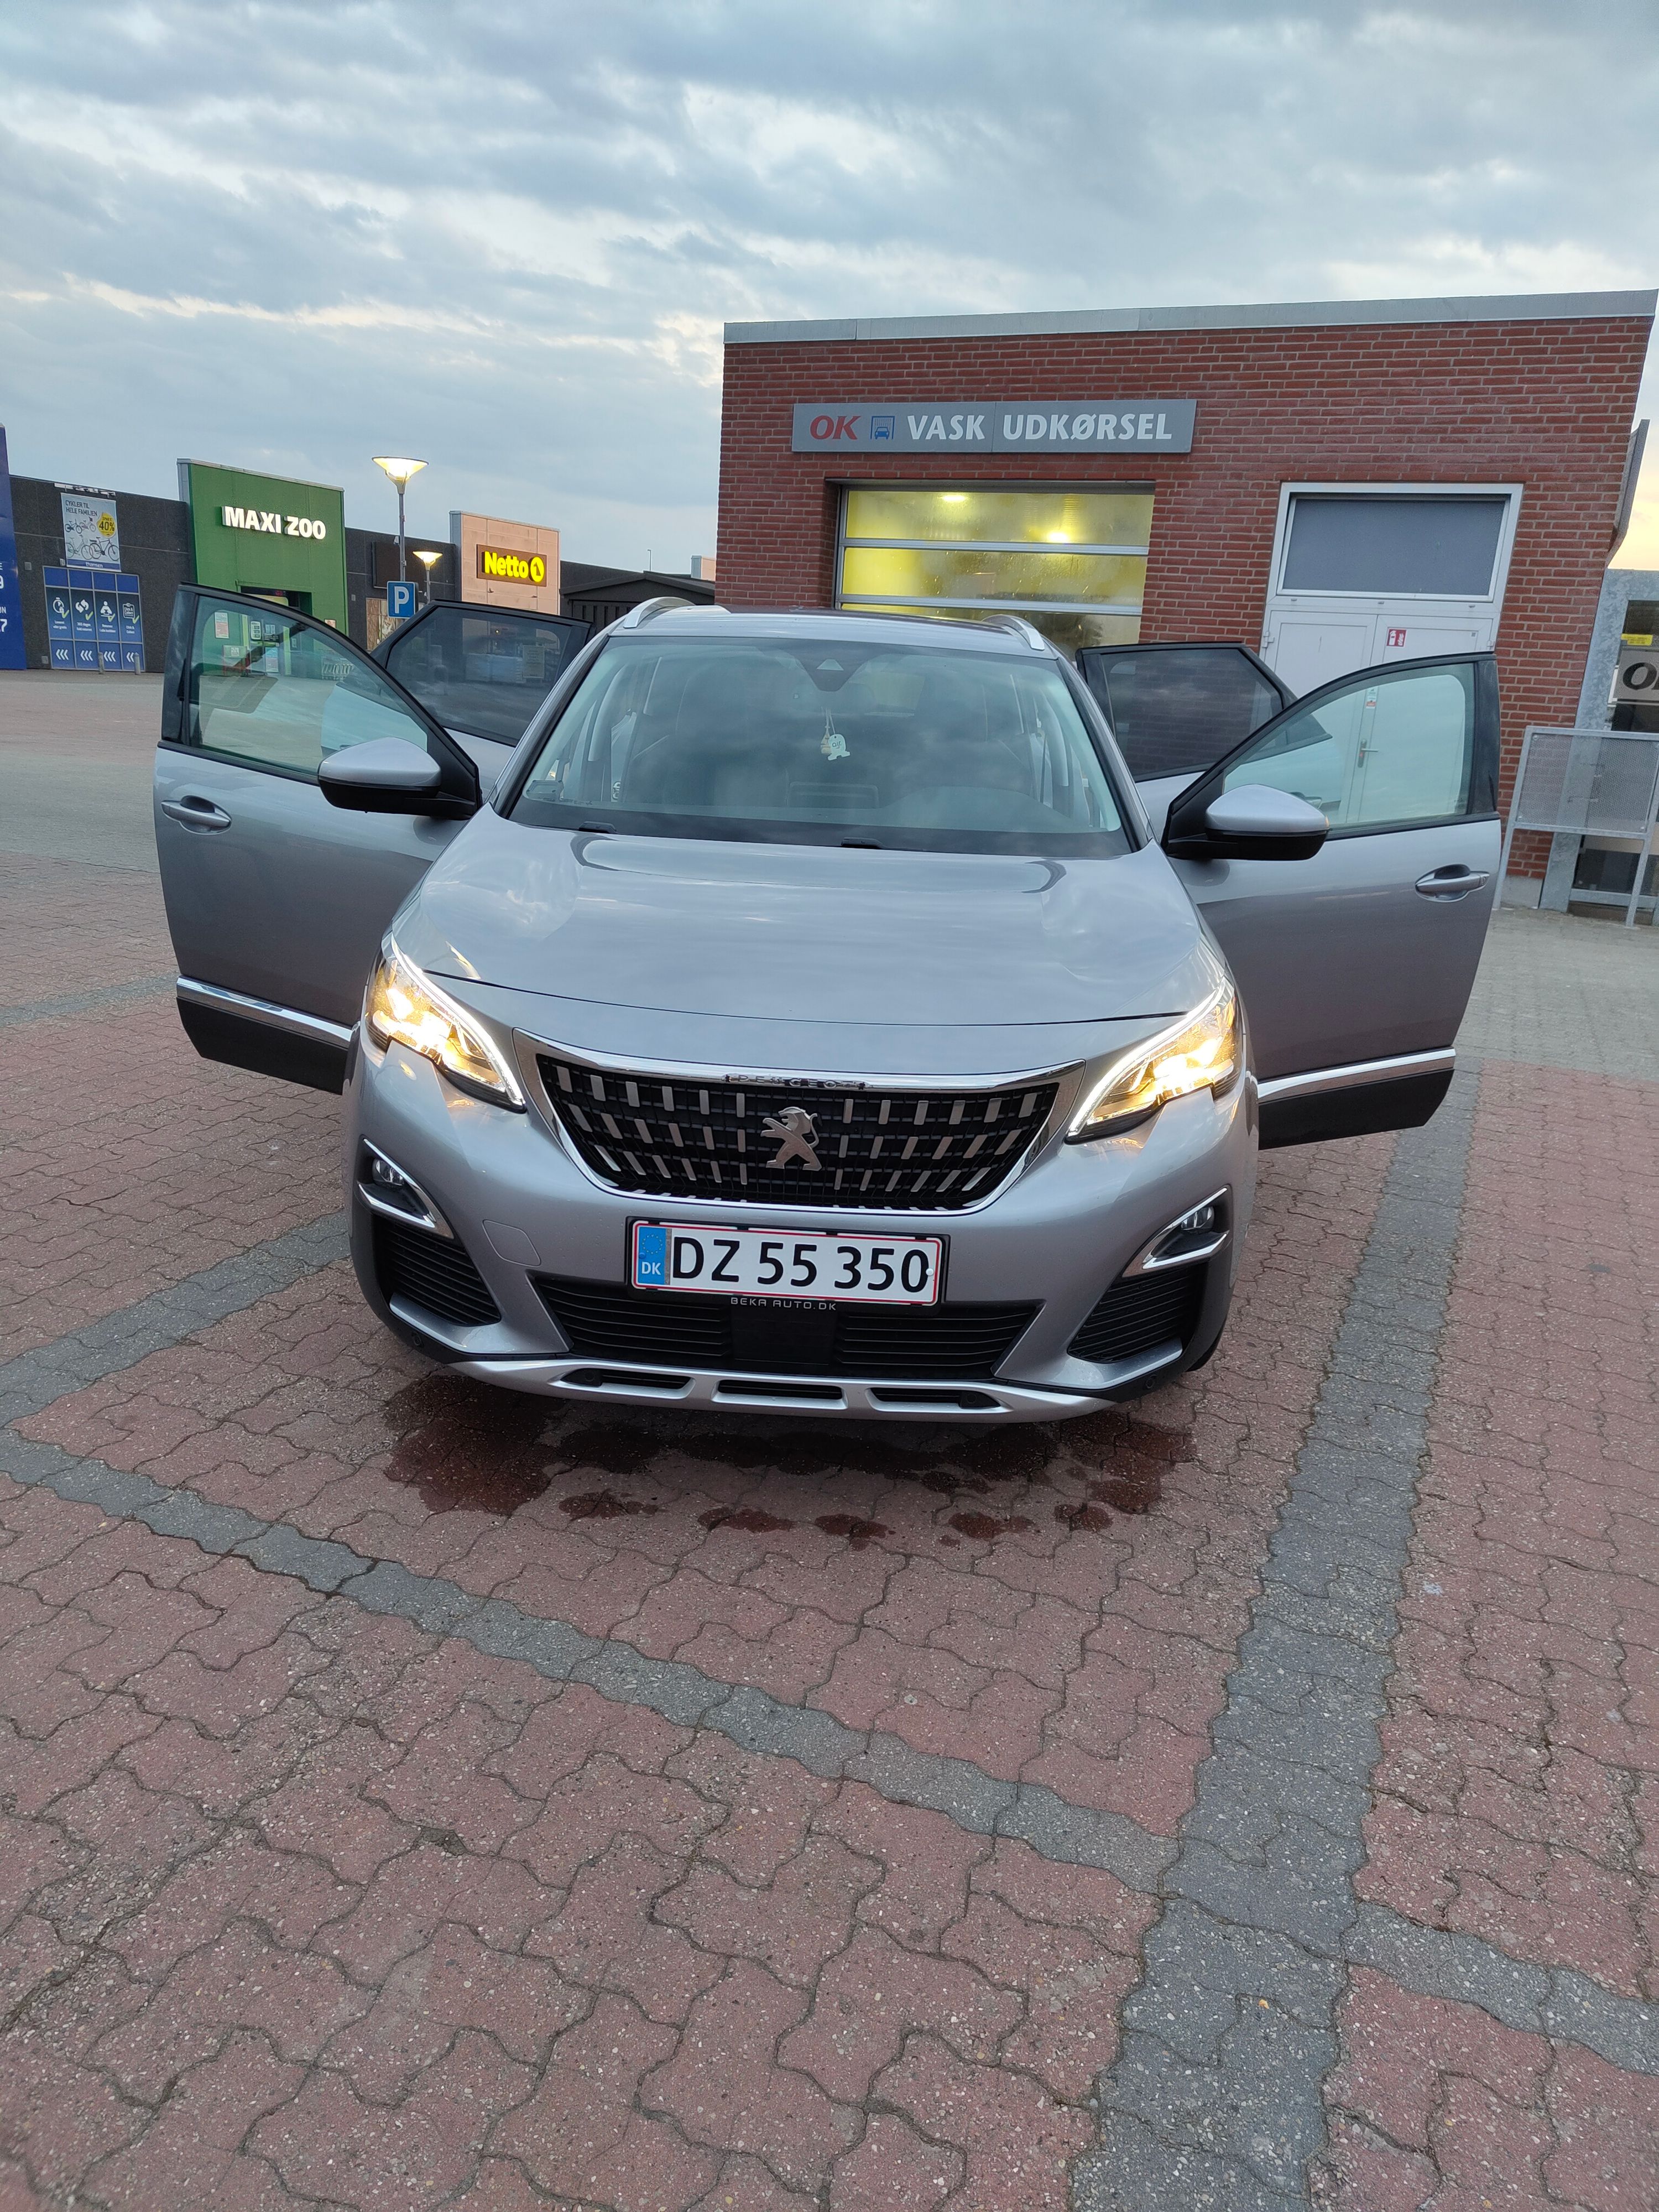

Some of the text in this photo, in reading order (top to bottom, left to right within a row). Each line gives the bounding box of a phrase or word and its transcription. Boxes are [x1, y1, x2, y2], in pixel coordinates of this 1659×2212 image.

[810, 413, 1172, 441] OK VASK UDKØRSEL
[78, 508, 97, 517] FAMILIEN
[98, 521, 115, 531] 40%
[222, 505, 326, 540] MAXI ZOO
[483, 551, 529, 578] Netto
[394, 586, 410, 614] P
[1623, 662, 1659, 690] O
[641, 1261, 661, 1276] DK
[672, 1237, 930, 1293] DZ 55 350
[731, 1297, 837, 1311] BEKA AUTO.DK
